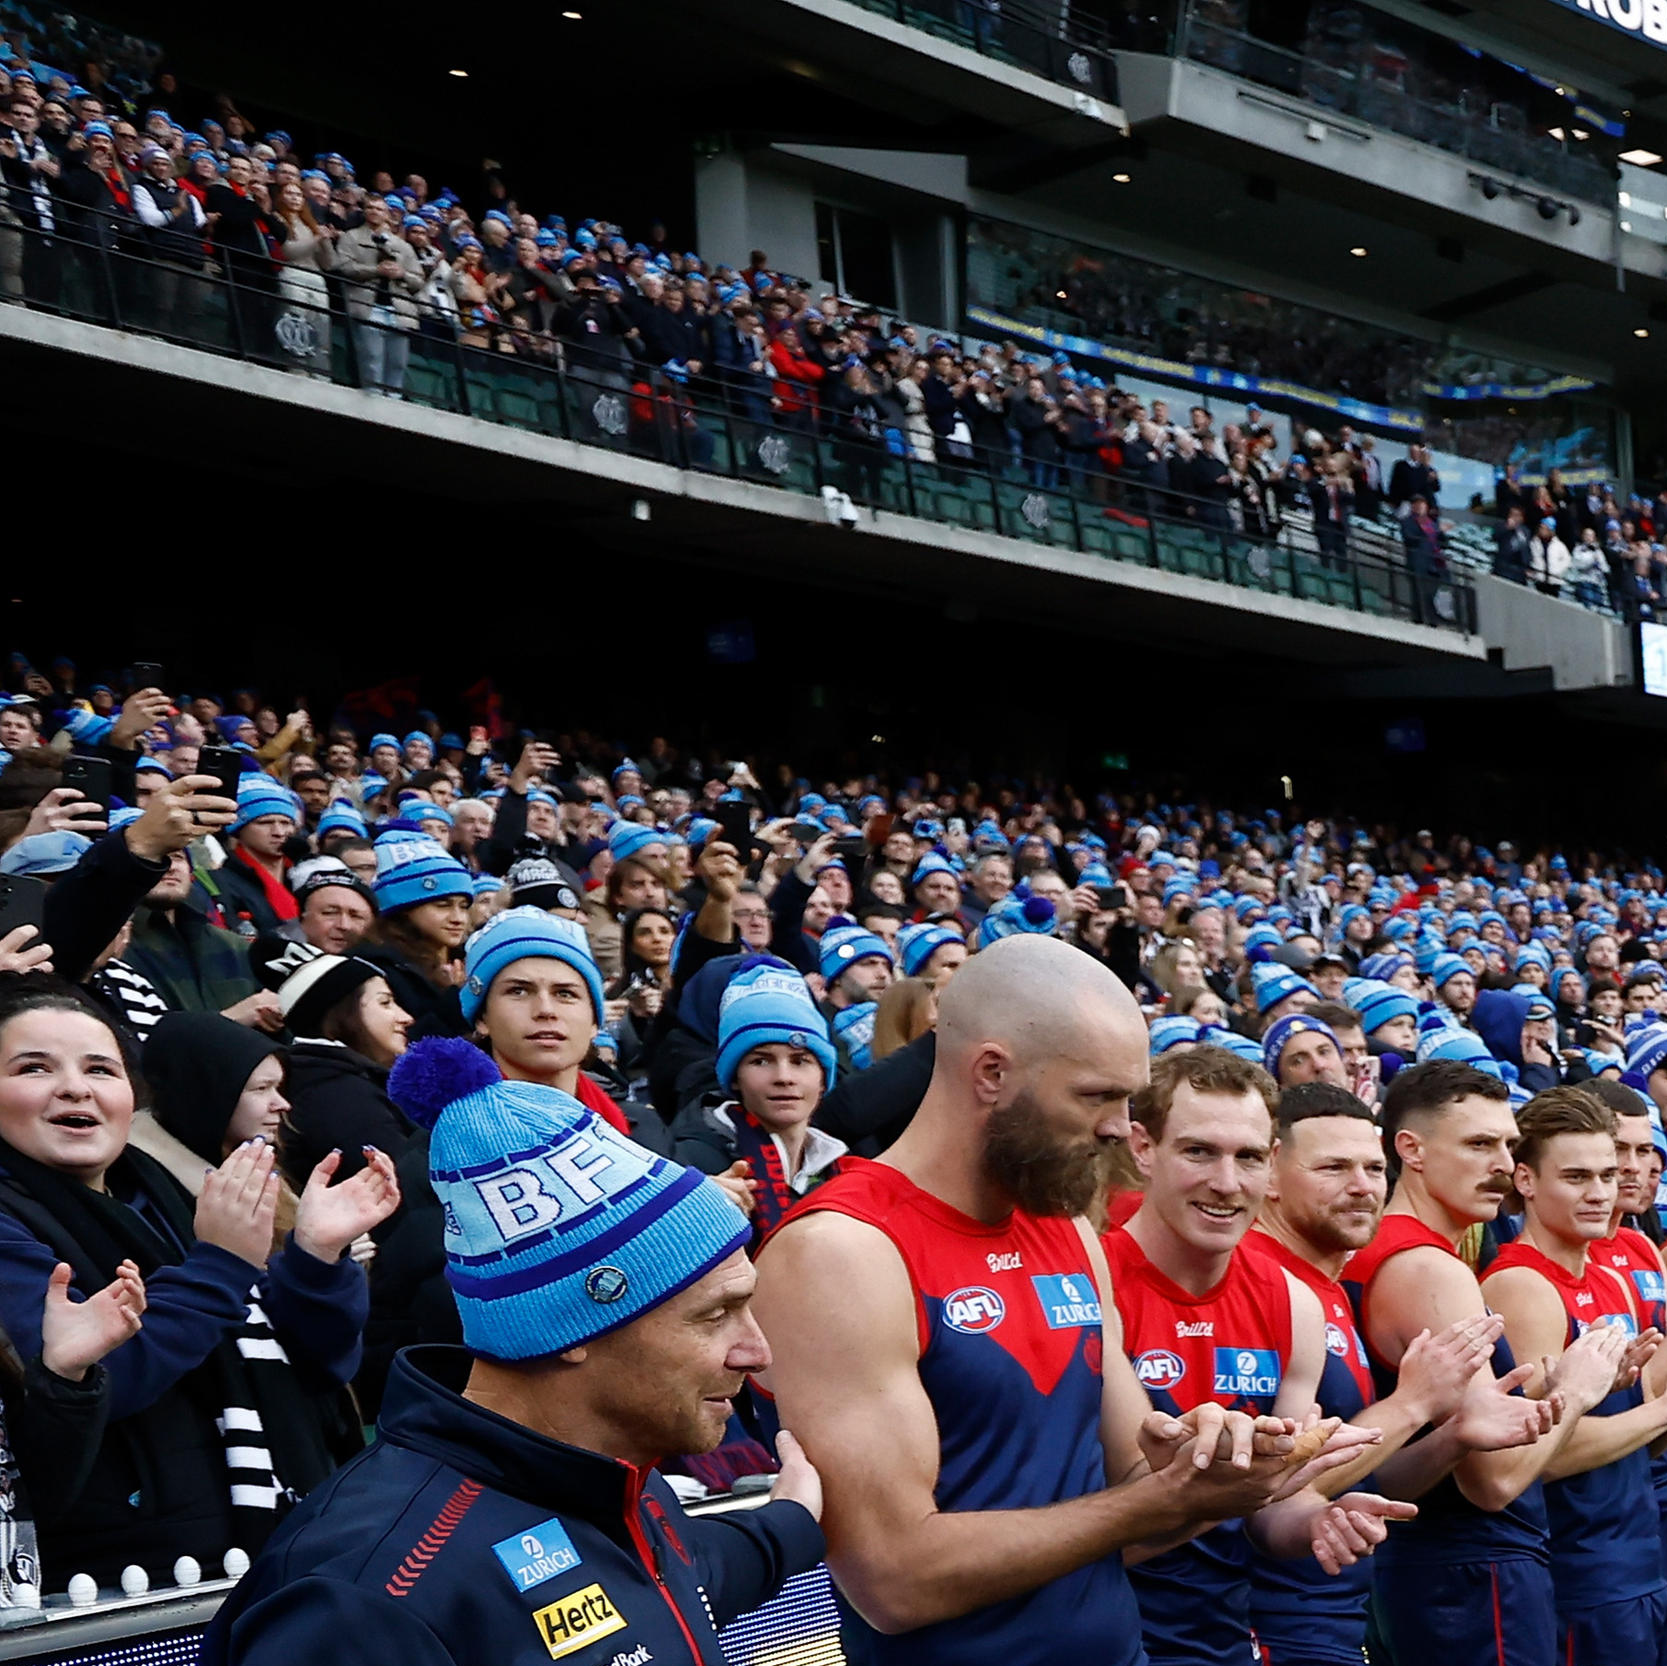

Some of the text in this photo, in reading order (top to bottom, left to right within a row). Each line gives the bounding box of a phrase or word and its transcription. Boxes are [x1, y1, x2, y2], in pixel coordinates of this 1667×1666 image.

[947, 1295, 1002, 1326] AFL
[1051, 1302, 1102, 1325] ZURIC
[1140, 1359, 1180, 1381] AFL
[1213, 1375, 1277, 1394] ZURICH
[517, 1548, 577, 1587] ZURICH
[543, 1593, 615, 1647] Hertz
